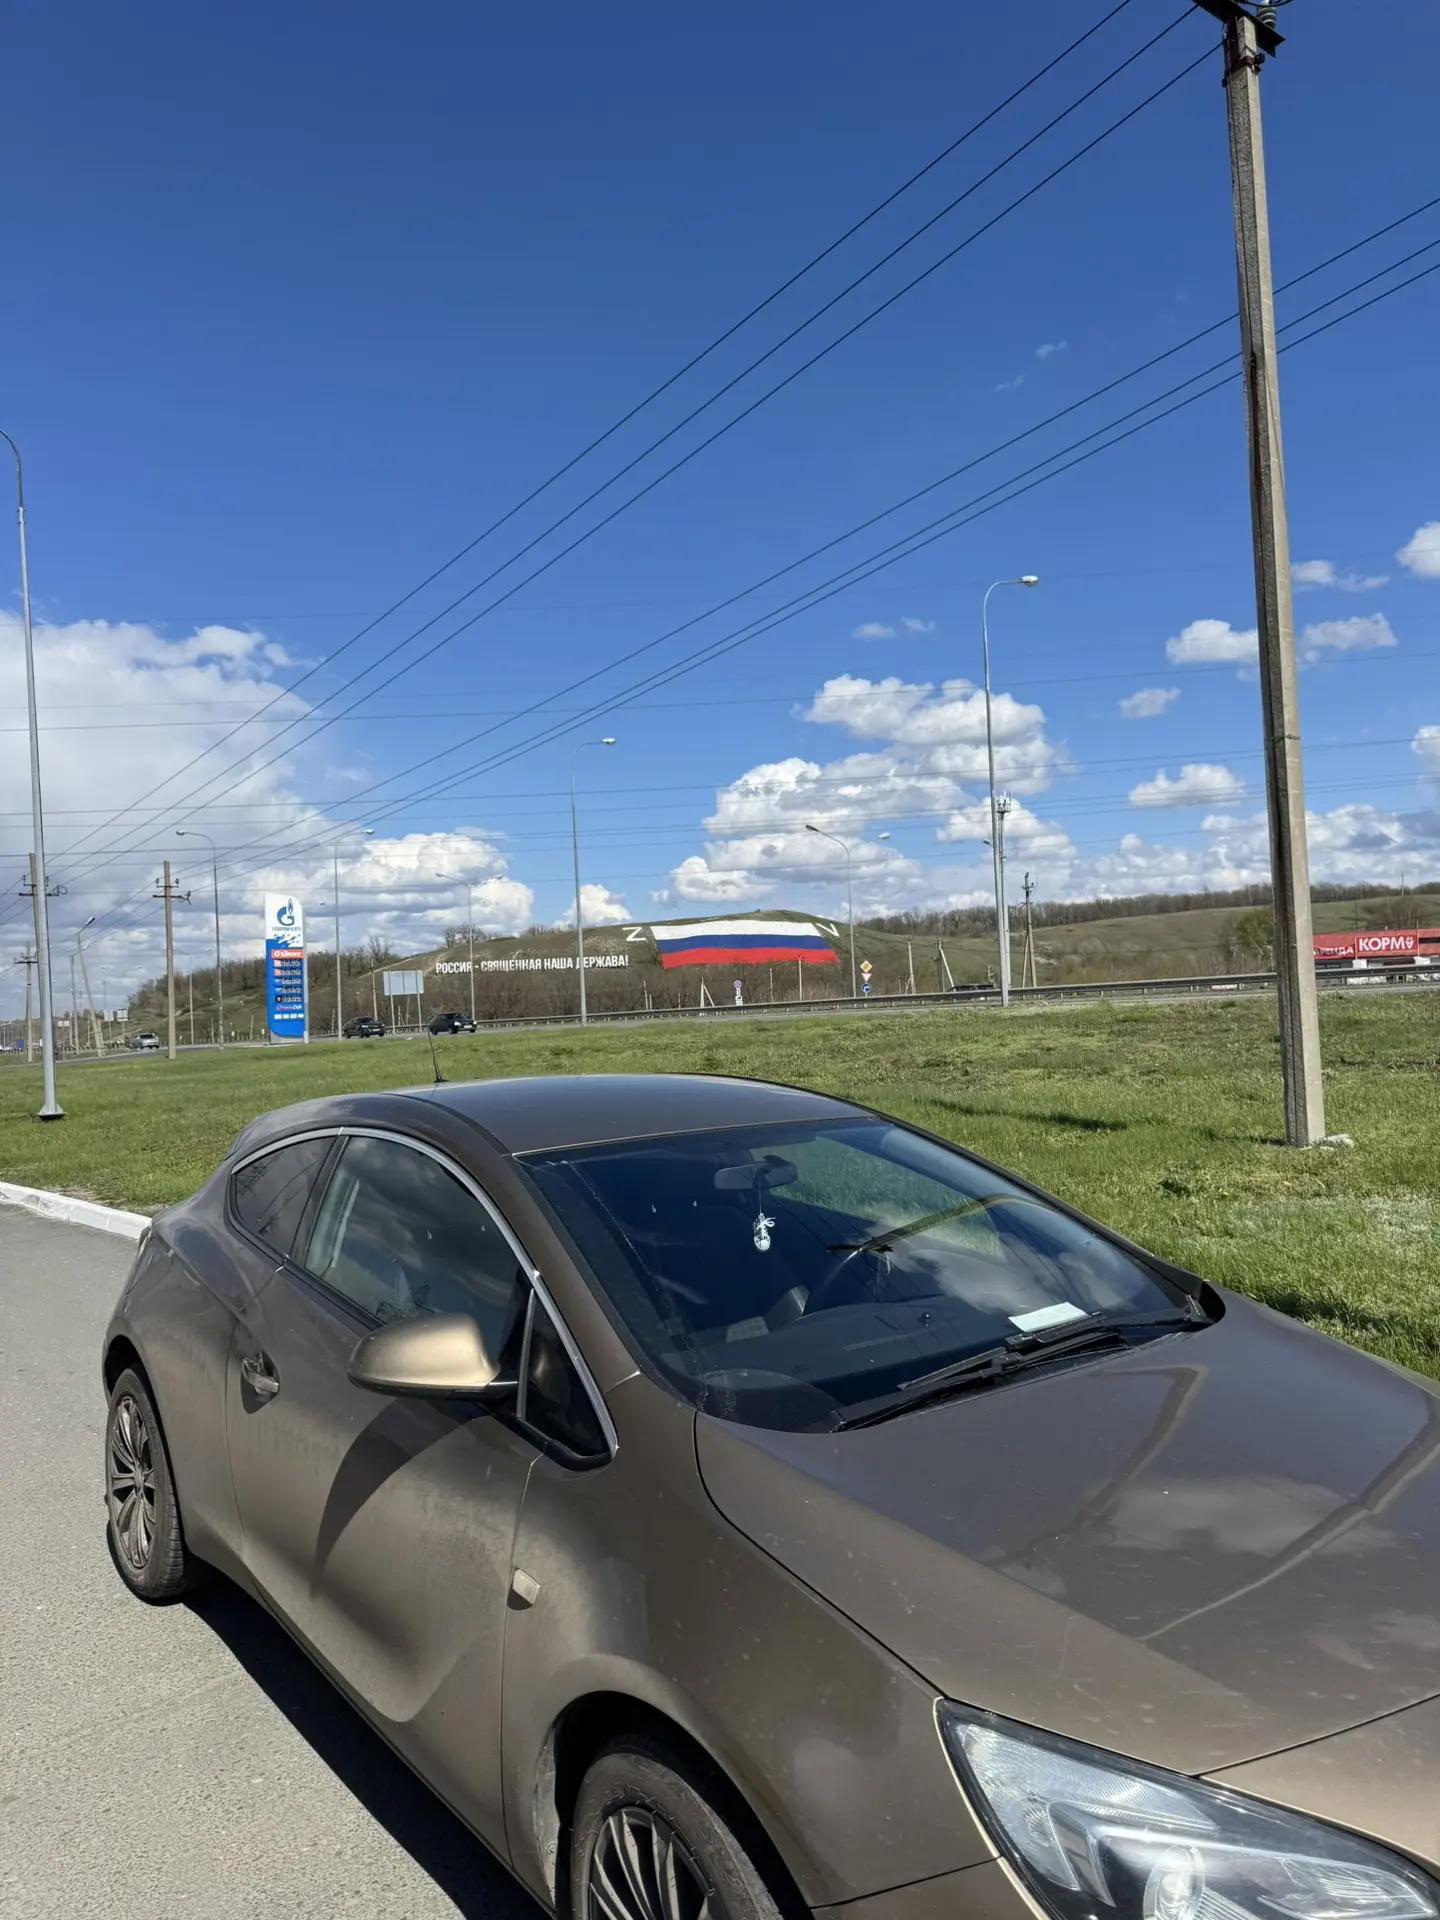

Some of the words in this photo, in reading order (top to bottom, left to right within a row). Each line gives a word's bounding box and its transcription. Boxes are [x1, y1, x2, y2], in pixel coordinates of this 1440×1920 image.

[622, 926, 647, 941] Z
[435, 961, 472, 974] РОССИЯ
[480, 958, 542, 972] СВЯЩЕННАЯ
[544, 957, 573, 970] НАША
